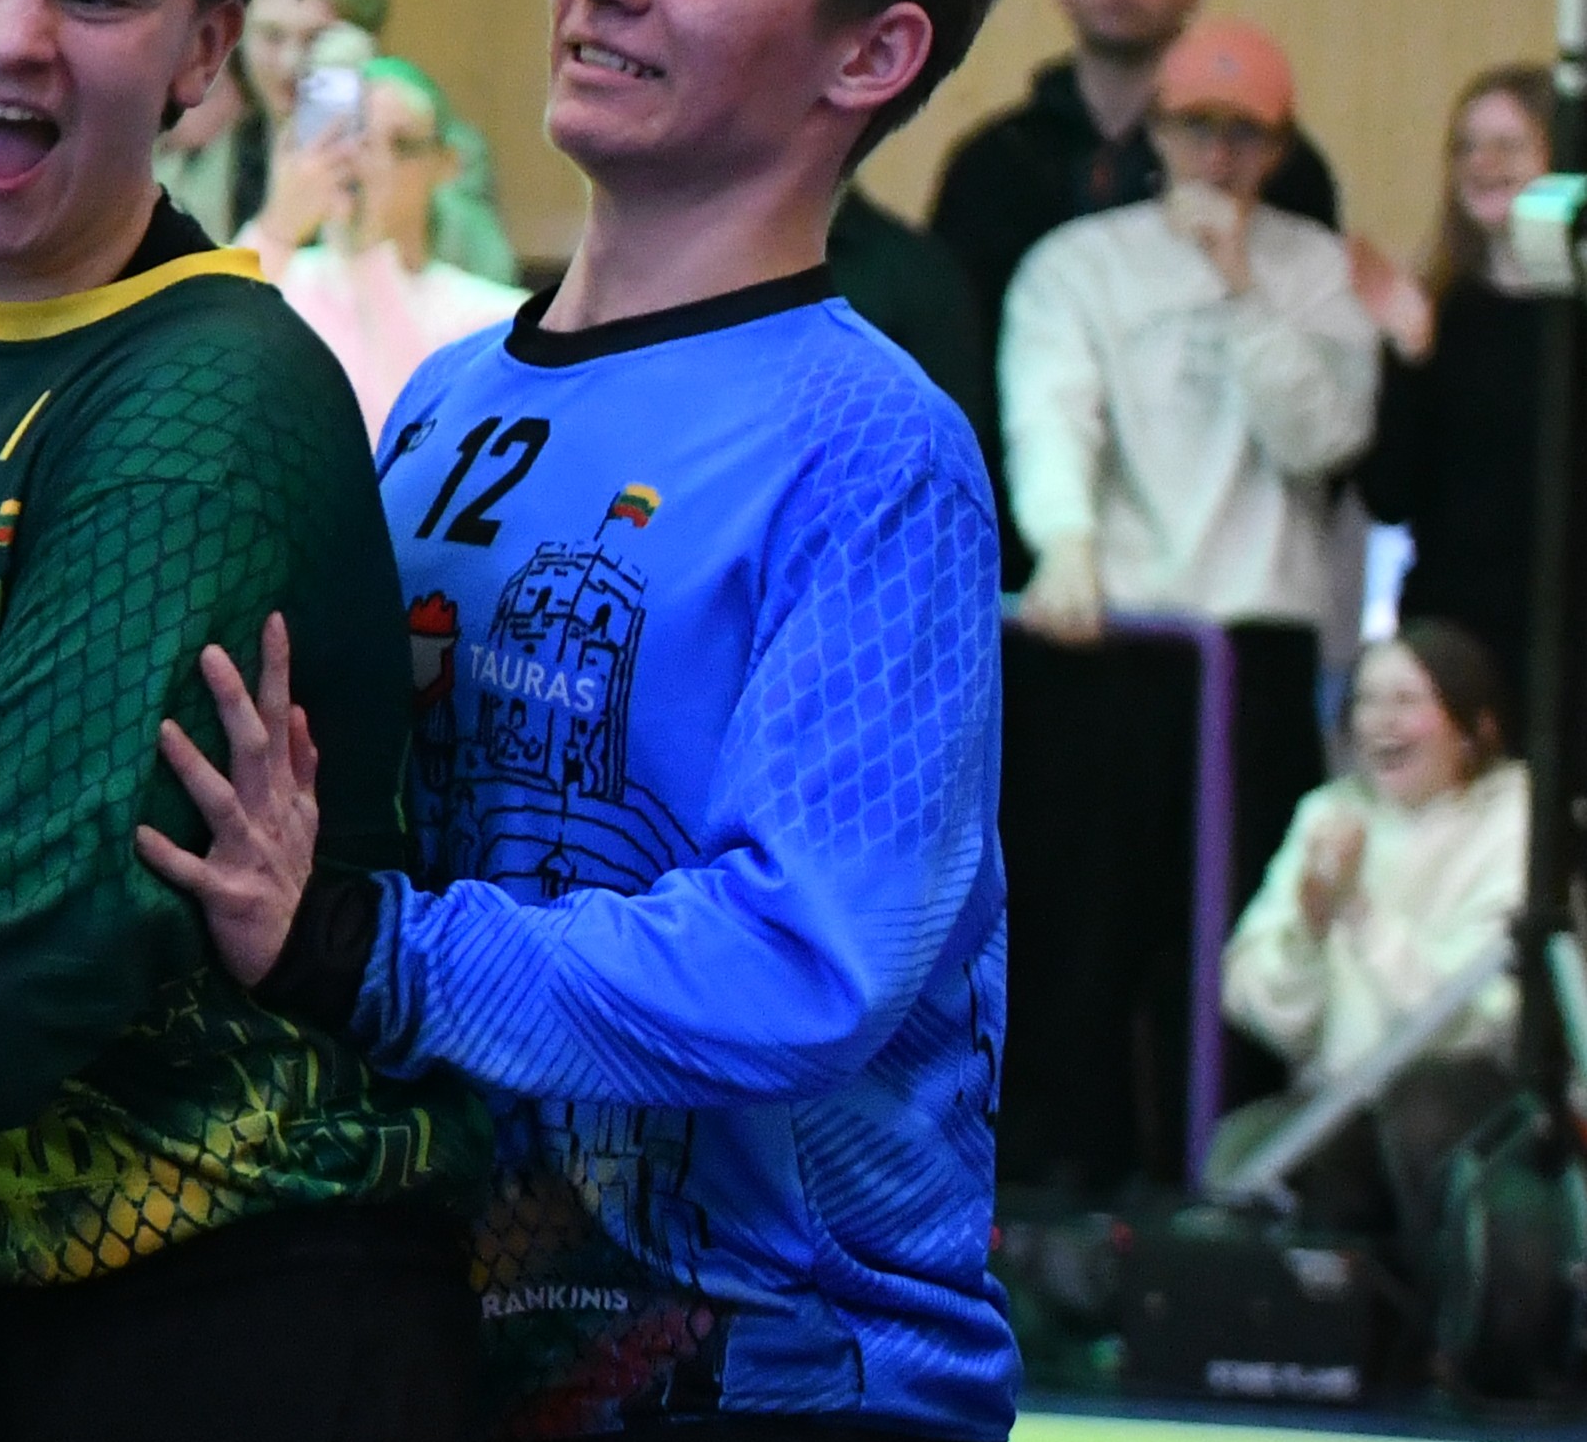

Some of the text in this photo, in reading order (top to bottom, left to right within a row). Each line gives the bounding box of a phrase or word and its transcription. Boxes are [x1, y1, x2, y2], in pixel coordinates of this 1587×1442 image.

[415, 416, 551, 547] 12
[470, 644, 596, 713] TAURAS
[481, 1285, 630, 1319] RANKINIS
